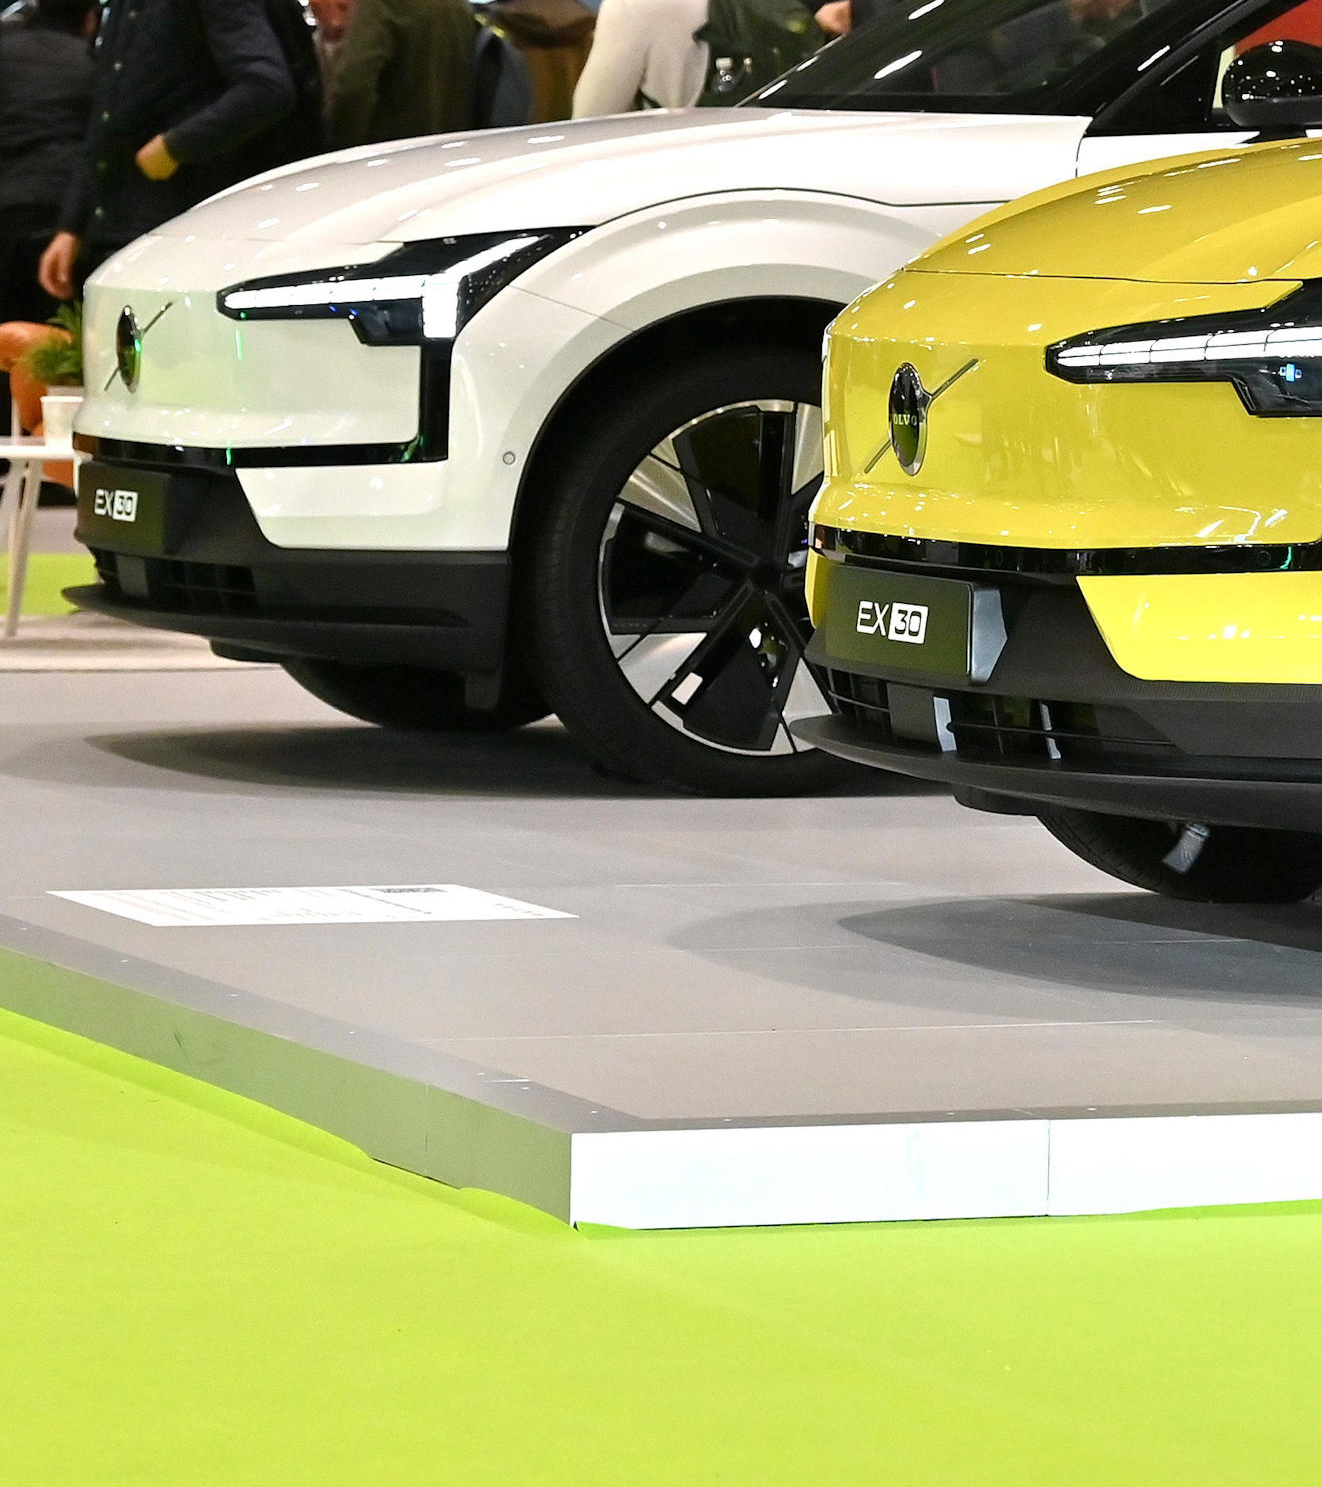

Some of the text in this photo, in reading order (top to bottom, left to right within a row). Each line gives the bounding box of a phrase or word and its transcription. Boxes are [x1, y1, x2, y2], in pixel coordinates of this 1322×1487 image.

[893, 413, 918, 427] OLVO
[94, 489, 138, 522] EX30
[857, 600, 929, 645] EX30
